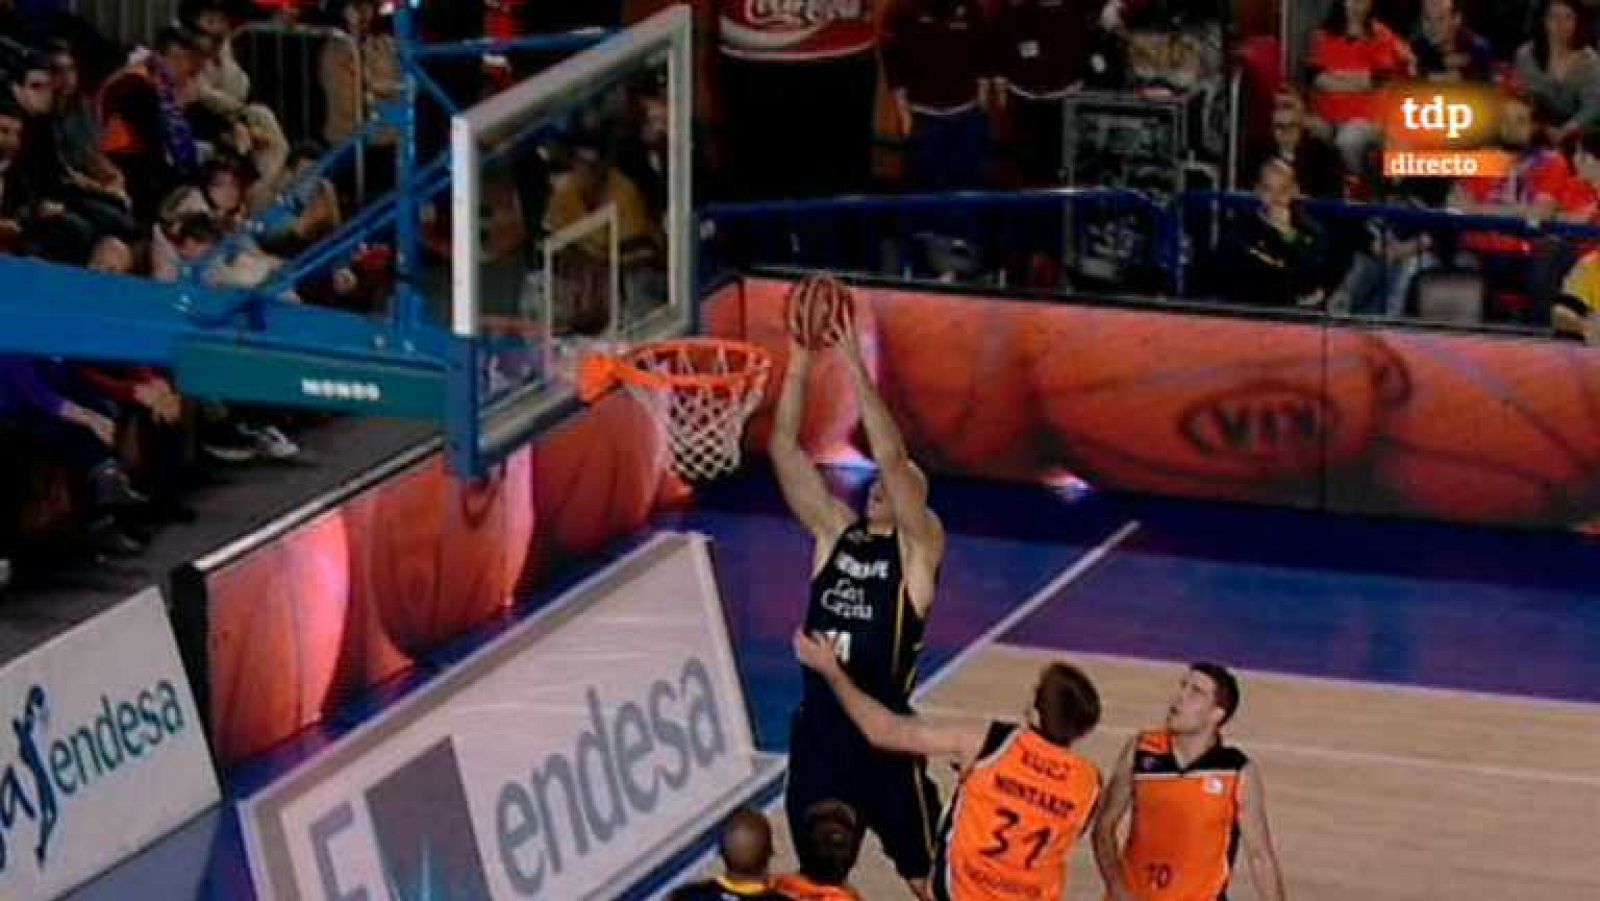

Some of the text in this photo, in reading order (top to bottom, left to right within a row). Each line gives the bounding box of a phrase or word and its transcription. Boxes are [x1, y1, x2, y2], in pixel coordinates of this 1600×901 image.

[51, 680, 184, 795] endesa
[496, 657, 725, 896] endesa
[979, 806, 1052, 870] 31
